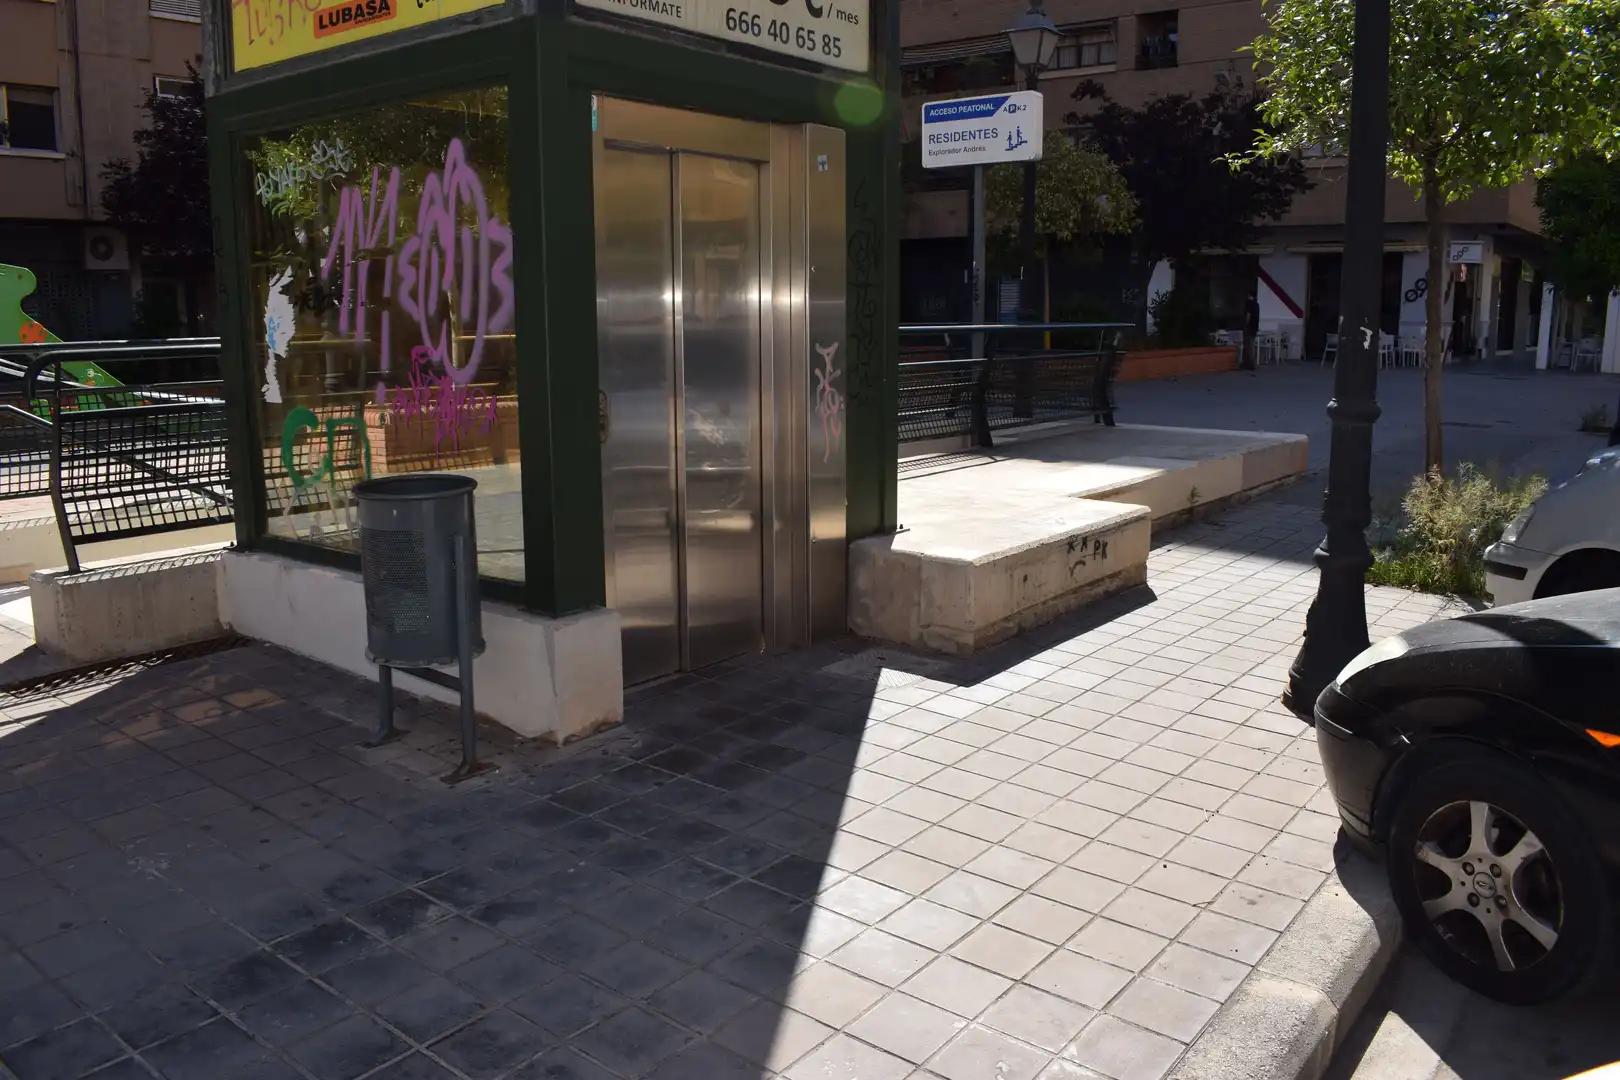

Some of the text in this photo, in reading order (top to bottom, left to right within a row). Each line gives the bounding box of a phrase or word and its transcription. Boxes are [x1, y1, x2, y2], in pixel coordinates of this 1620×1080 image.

[318, 0, 391, 30] LUBASA
[608, 0, 683, 18] ORMATE
[725, 7, 842, 58] 666 40 65 85
[929, 103, 995, 117] ACCESO PEATONAL
[928, 127, 999, 145] RESIDENTES
[928, 147, 962, 156] Explorador
